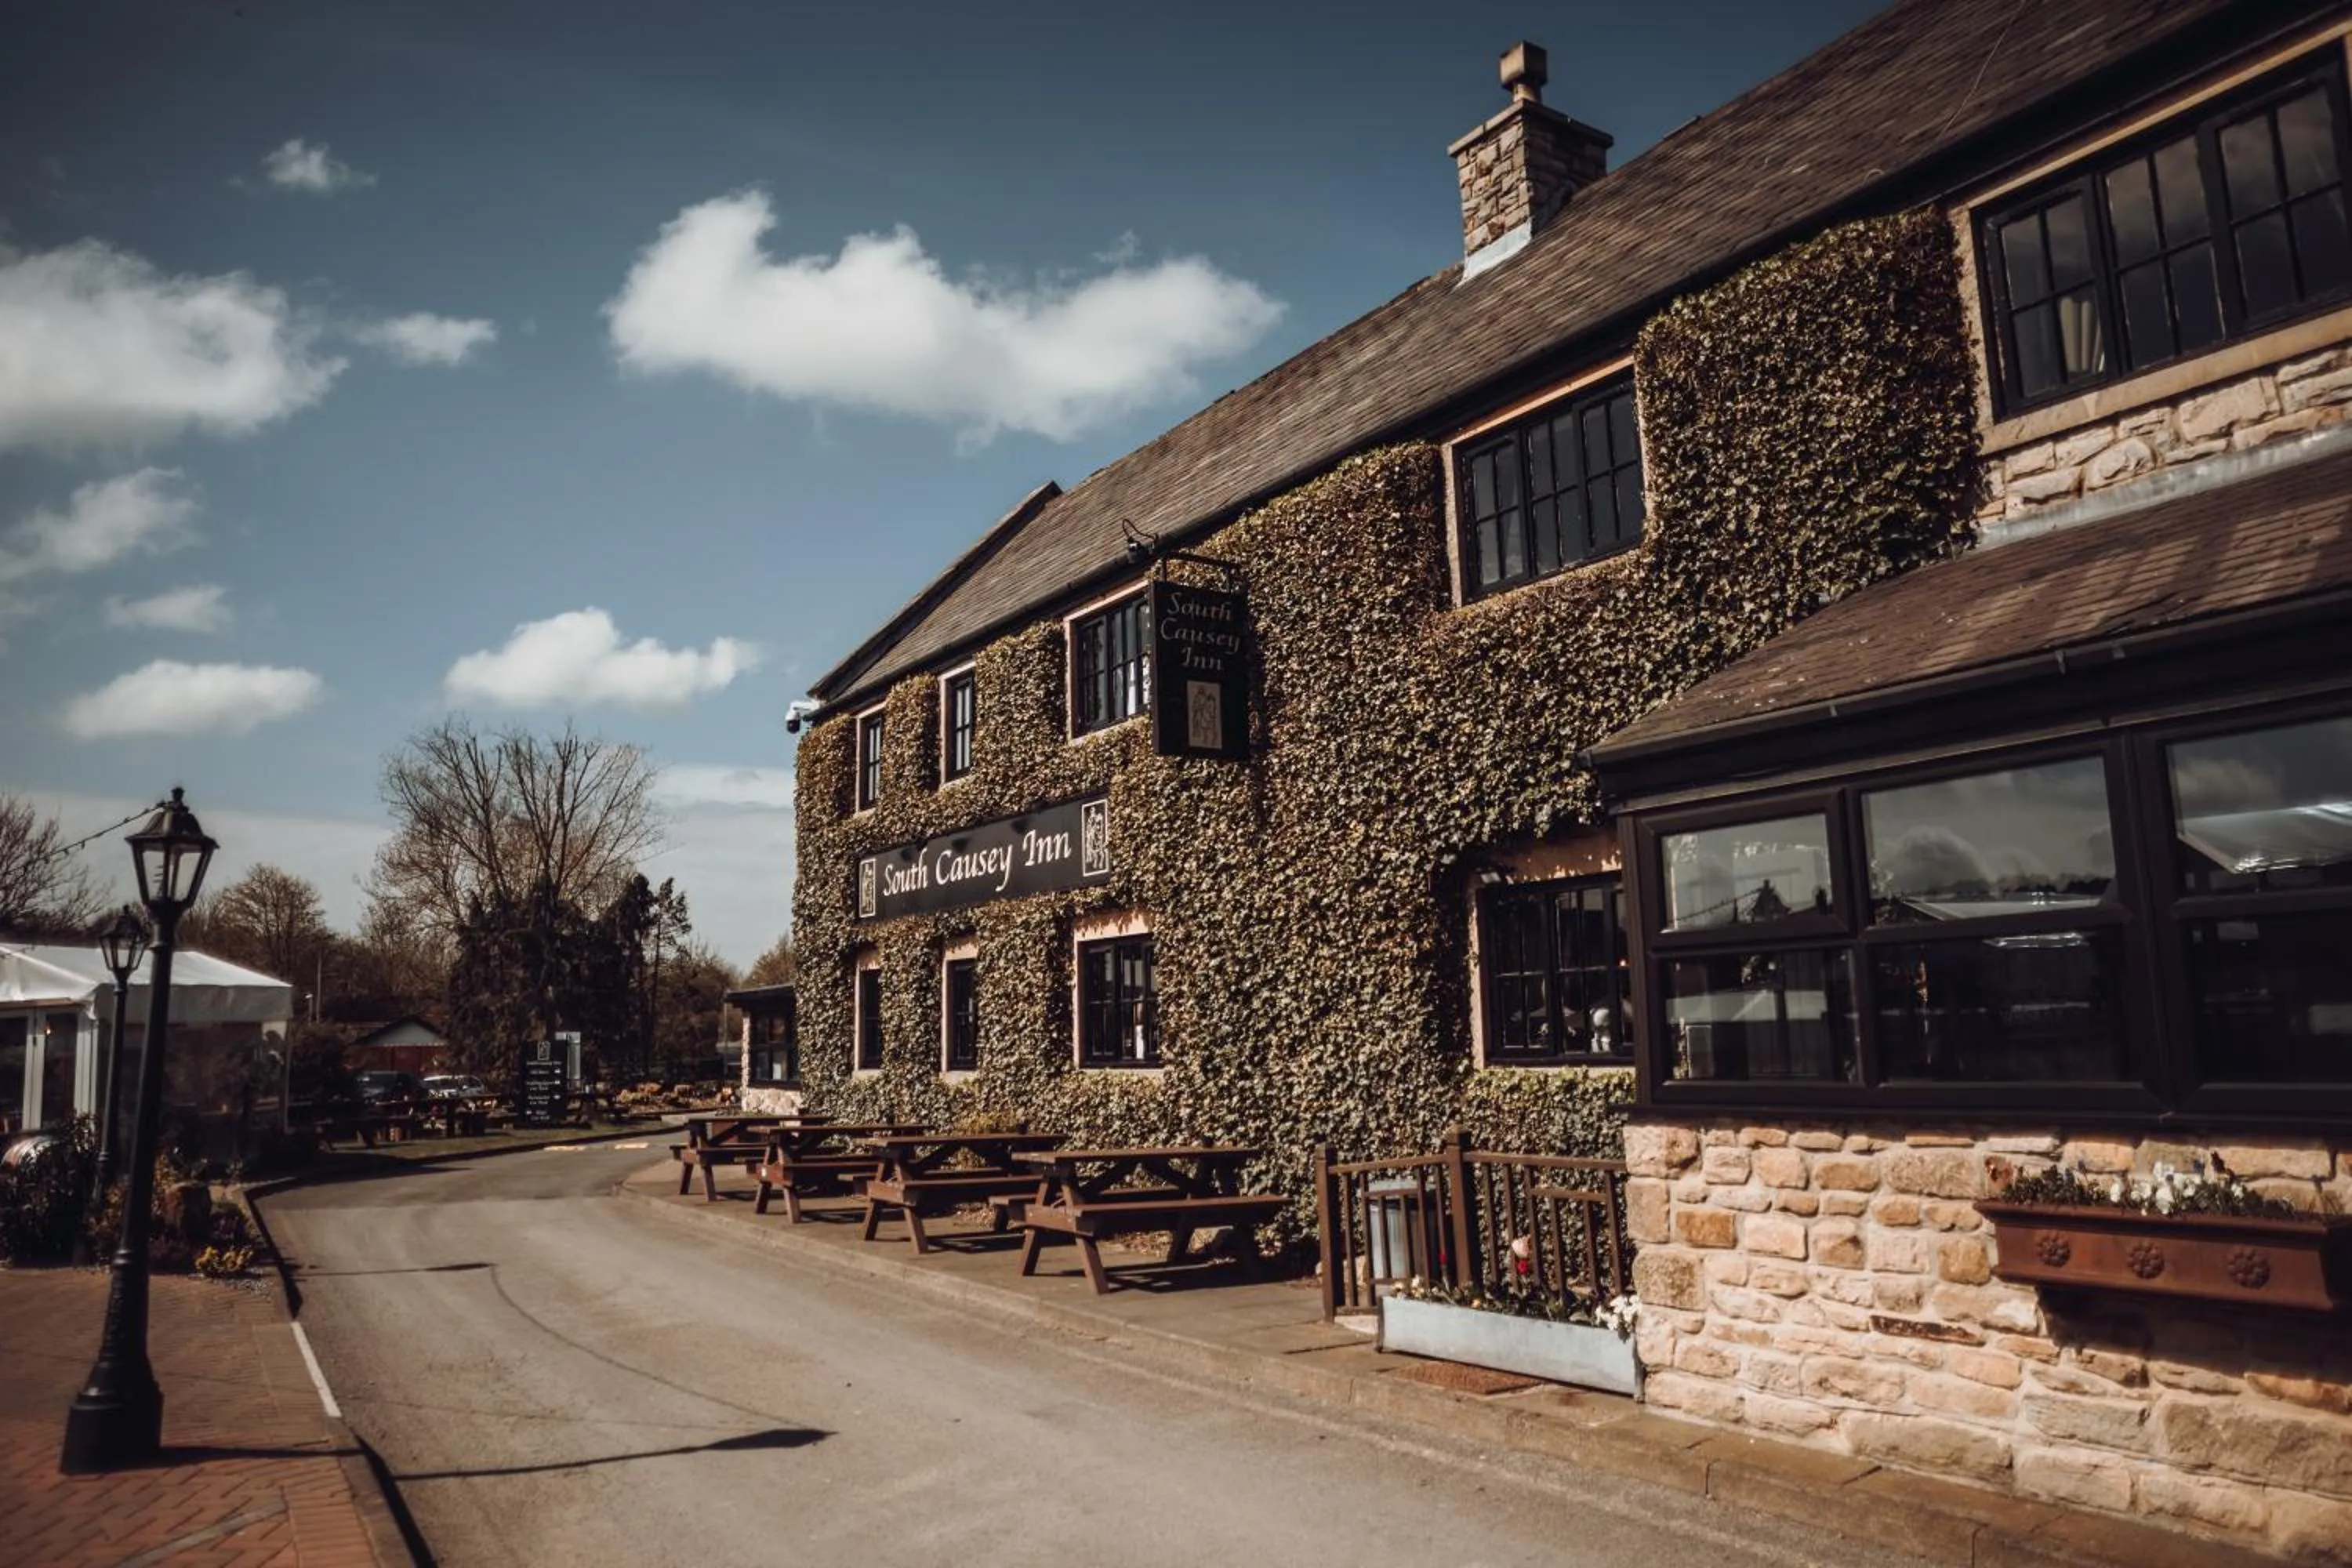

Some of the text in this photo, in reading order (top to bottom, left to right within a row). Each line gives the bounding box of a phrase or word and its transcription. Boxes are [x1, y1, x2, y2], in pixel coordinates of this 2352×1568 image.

[1167, 592, 1232, 621] South
[1161, 618, 1240, 654] Causey
[1181, 647, 1221, 671] Inn
[883, 829, 1072, 896] South Causey Inn
